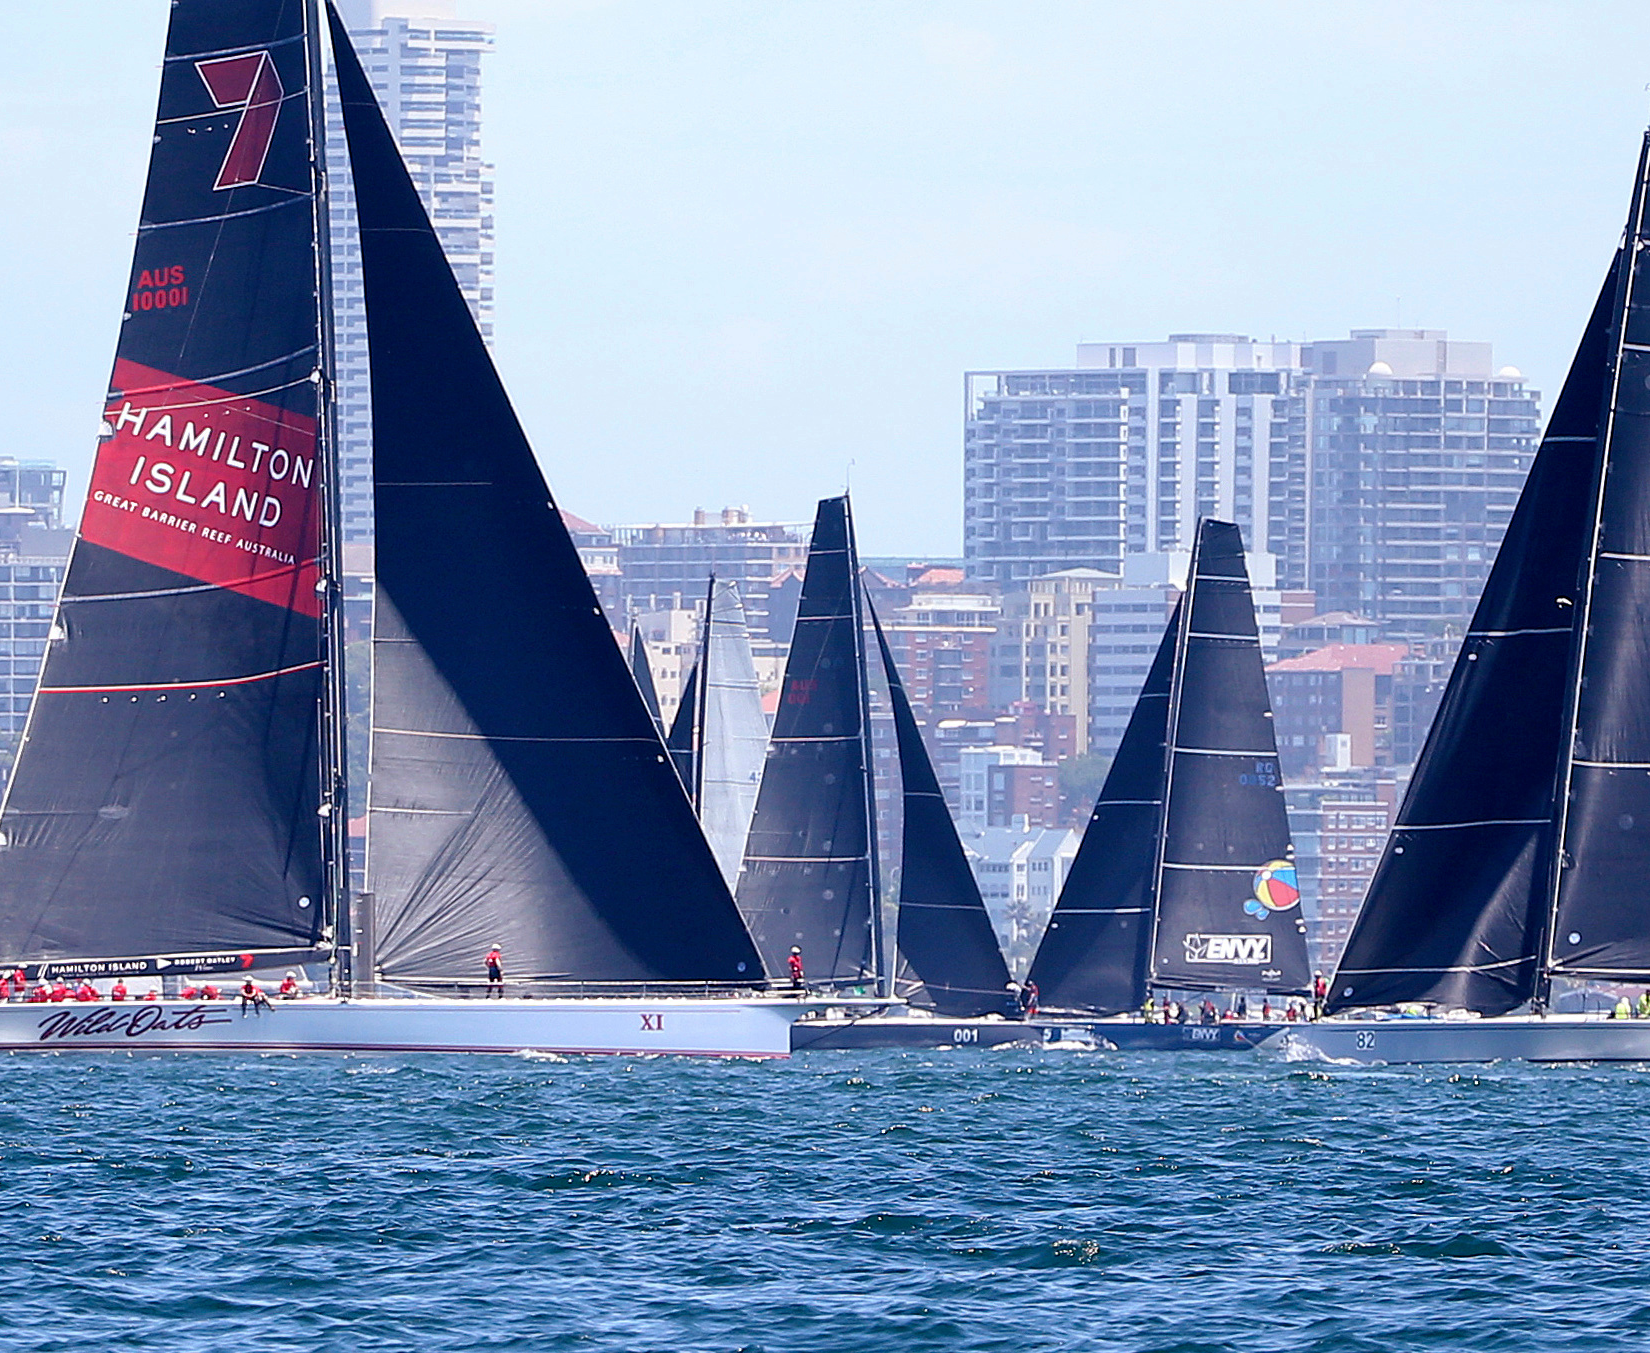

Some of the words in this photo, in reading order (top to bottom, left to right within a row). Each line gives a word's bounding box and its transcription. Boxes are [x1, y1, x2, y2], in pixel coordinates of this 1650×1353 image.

[137, 265, 186, 289] AUS
[132, 286, 189, 311] 10001
[116, 401, 314, 488] HAMILTON
[129, 456, 281, 528] ISLAND
[94, 490, 138, 513] GREAT
[141, 506, 198, 534] BARRIER
[201, 527, 232, 544] REEF
[236, 538, 295, 565] AUSTRALIA
[51, 963, 106, 974] HAMILTON
[108, 961, 147, 971] ISLAND
[38, 1006, 130, 1041] Wild
[125, 1005, 232, 1037] Oats
[640, 1014, 665, 1031] XI
[954, 1029, 978, 1042] 001
[1357, 1032, 1374, 1048] 82
